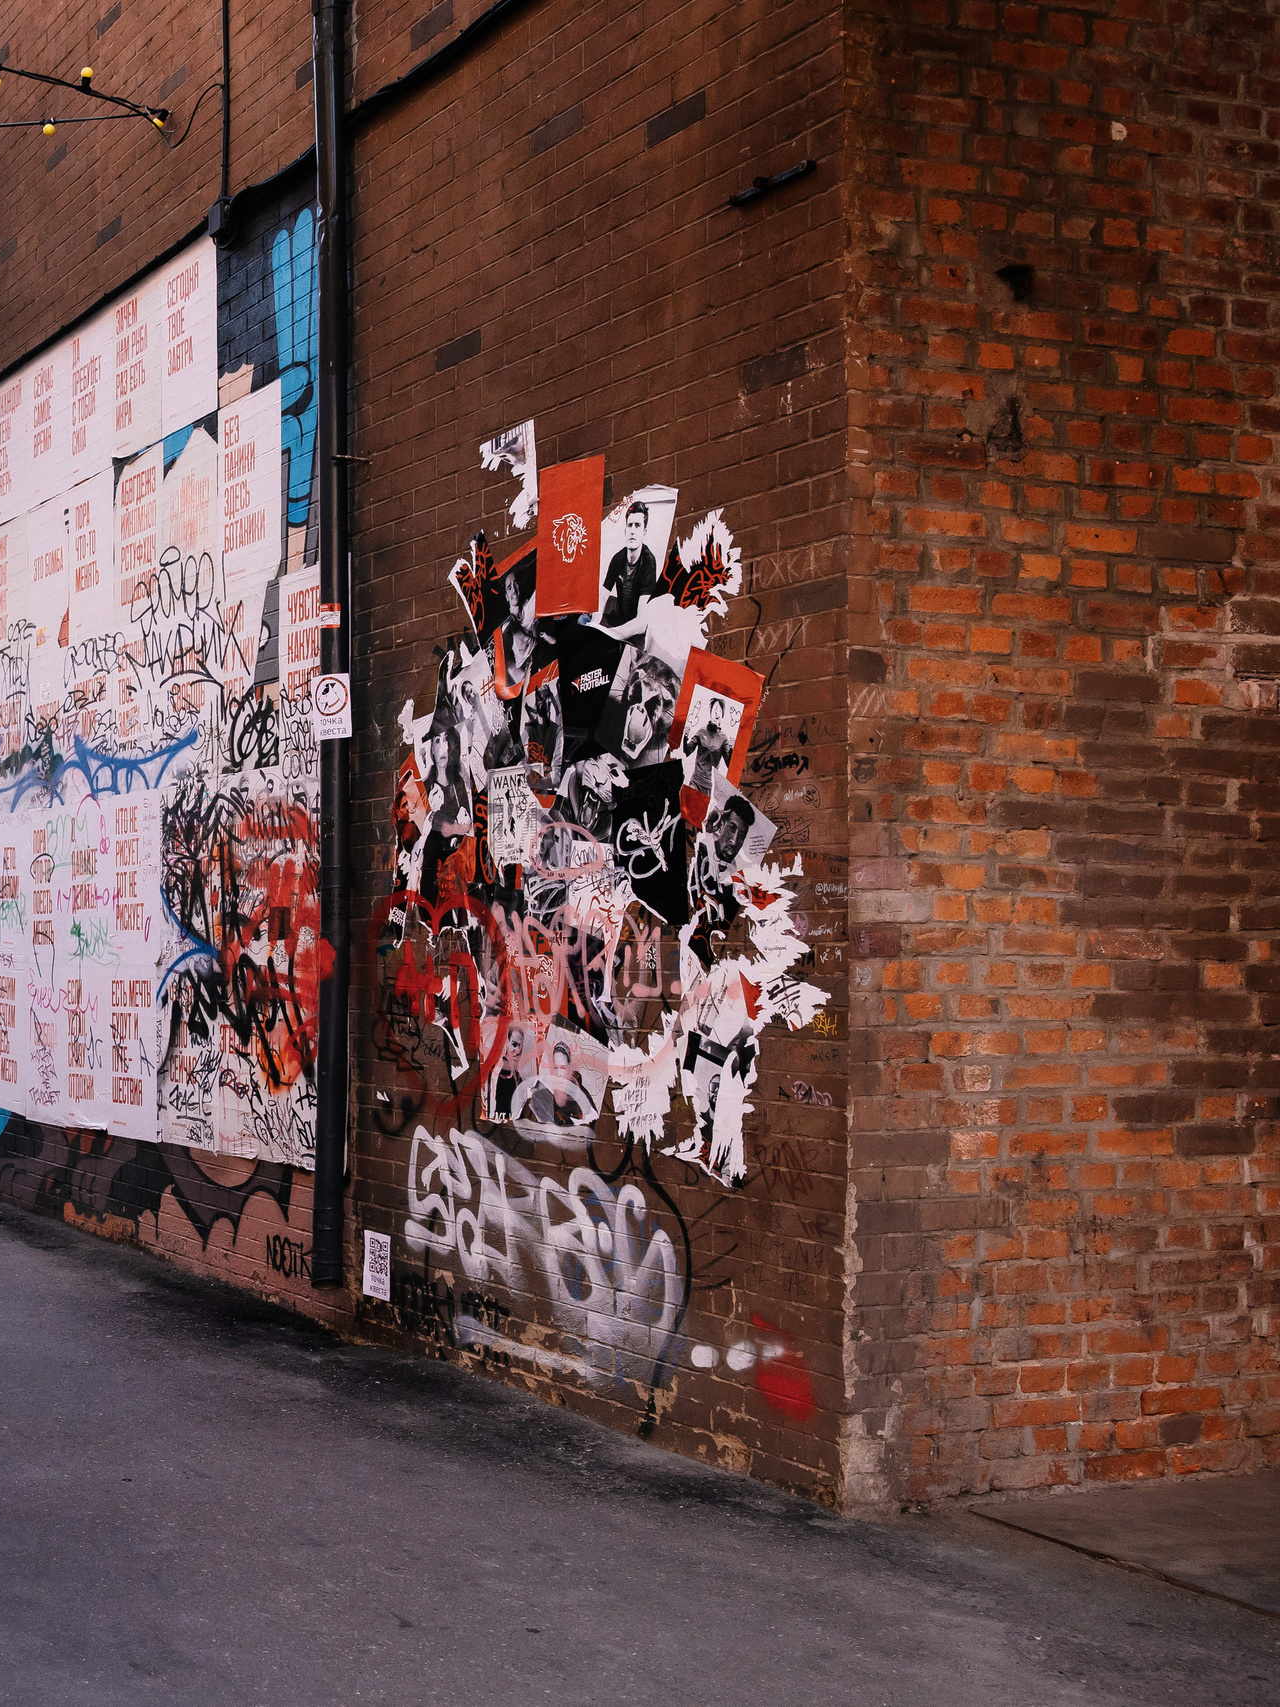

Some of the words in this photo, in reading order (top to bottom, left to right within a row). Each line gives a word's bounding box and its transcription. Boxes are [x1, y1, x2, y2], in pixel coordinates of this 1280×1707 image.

[166, 260, 198, 309] СЕГОДНЯ
[115, 296, 137, 336] ЗАЧЕМ
[168, 305, 185, 343] ТВОЕ
[72, 336, 80, 370] ДА
[115, 334, 128, 369] НАМ
[131, 321, 147, 359] РЫБА
[167, 333, 193, 378] ЗАВТРА
[33, 362, 53, 400] СЕЙЧАС
[115, 367, 127, 400] РАЗ
[129, 356, 145, 393] ЕСТЬ
[33, 394, 51, 429] САМОЕ
[72, 400, 76, 426] С
[77, 386, 95, 424] ТОБОЙ
[115, 396, 132, 432] ИКРА
[33, 424, 51, 458] ВРЕМЯ
[72, 424, 86, 457] СИЛА
[224, 413, 240, 449] БЕЗ
[224, 440, 255, 484] ПАНИКИ
[120, 464, 156, 508] АБВГДЕЖЗ
[224, 477, 250, 517] ЗДЕСЬ
[75, 499, 90, 532] ПОРА
[224, 508, 265, 554] БОТАНИКИ
[75, 528, 95, 562] ЧТО-ТО
[120, 533, 156, 573] РСТУФХЦЧ
[33, 555, 43, 582] ЭТО
[45, 545, 63, 577] БОМБА
[75, 558, 99, 593] МЕНЯТЬ
[580, 667, 602, 683] FASTER
[580, 673, 610, 692] FOOTBALL
[115, 807, 127, 835] КТО
[129, 805, 138, 833] НЕ
[33, 828, 46, 854] ПОРА
[71, 843, 97, 880] ДАВАЙТЕ
[33, 889, 52, 914] ПОЕСТЬ
[116, 871, 127, 898] ТОТ
[129, 871, 137, 898] НЕ
[33, 920, 54, 945] МЕНЯТЬ
[115, 903, 144, 931] РИСКУЕТ
[67, 978, 82, 1005] ЕСЛИ
[112, 980, 126, 1007] ЕСТЬ
[128, 979, 151, 1008] МЕЧТЫ
[112, 1012, 131, 1040] БУДУТ
[134, 1013, 138, 1040] И
[1, 1058, 17, 1084] МЕСТО
[68, 1071, 93, 1106] ОТДОХНИ
[112, 1075, 142, 1108] ШЕСТВИЯ
[369, 1285, 387, 1297] квеста
[370, 1274, 386, 1286] точка
